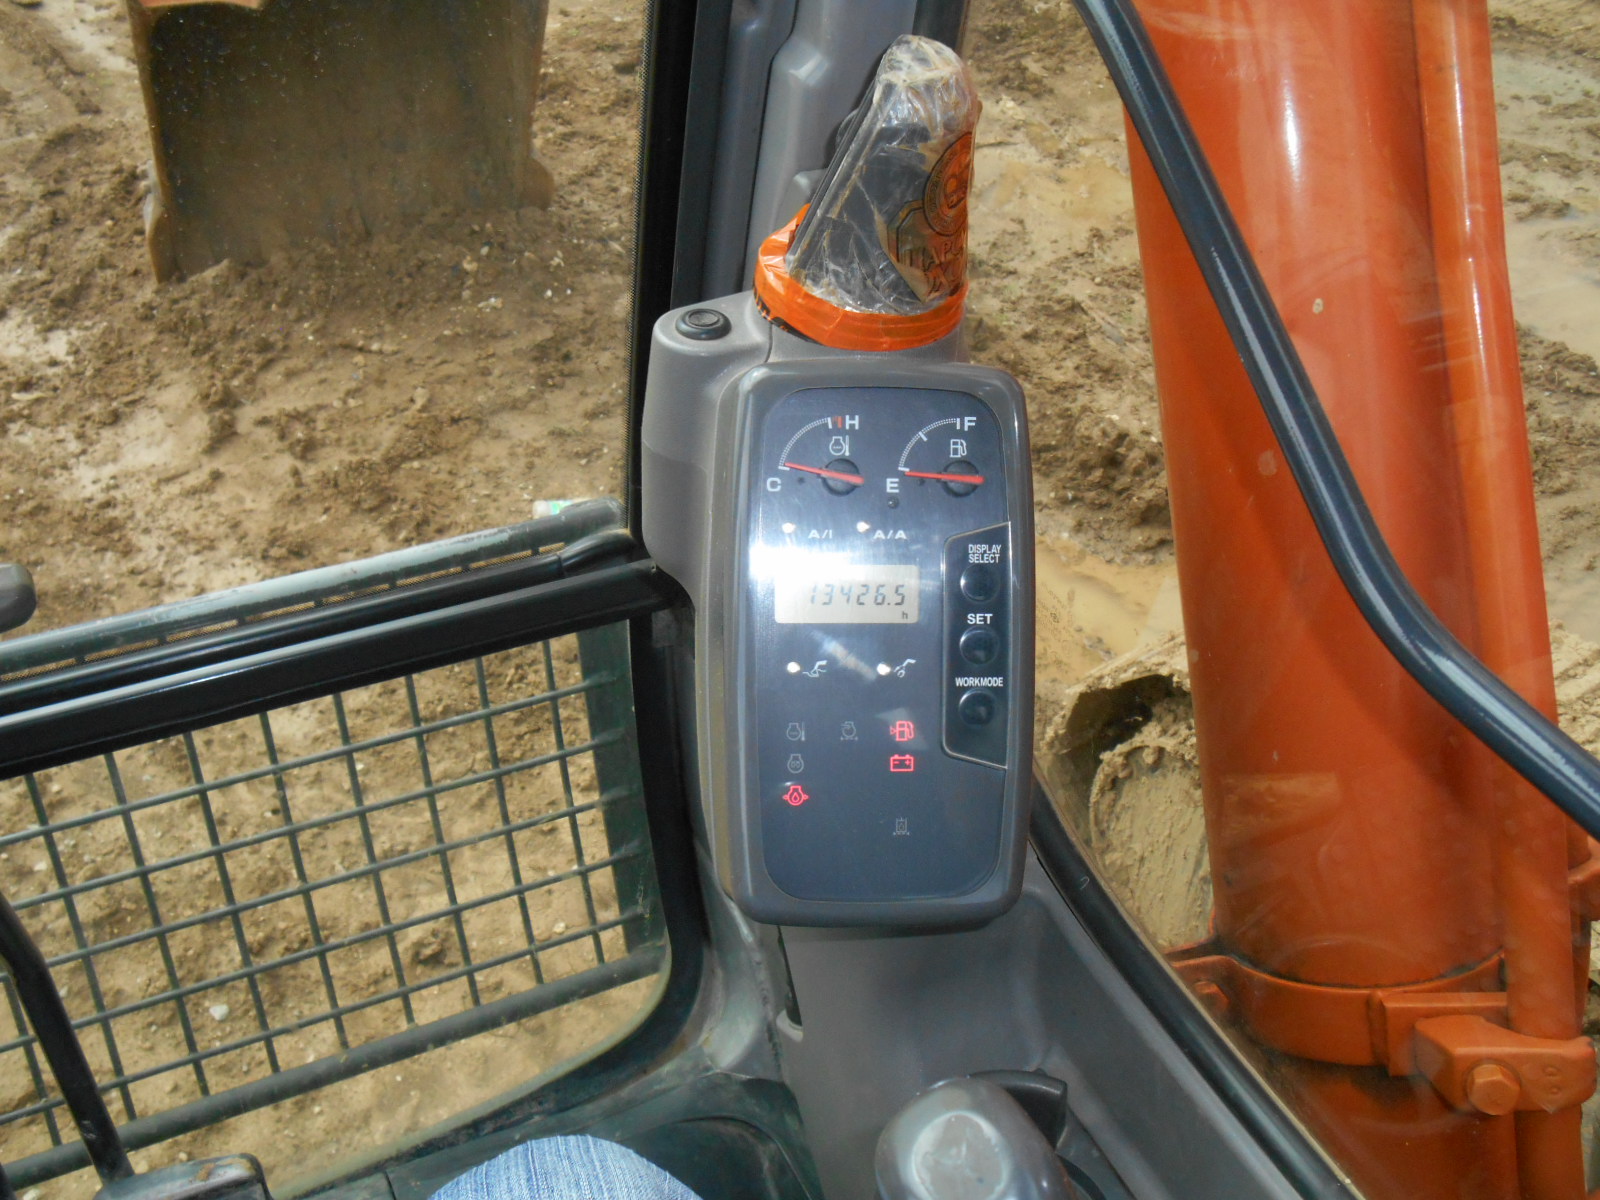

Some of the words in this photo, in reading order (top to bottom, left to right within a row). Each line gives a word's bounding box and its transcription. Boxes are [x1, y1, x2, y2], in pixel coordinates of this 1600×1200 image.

[845, 415, 859, 430] H
[964, 416, 977, 431] F
[766, 477, 782, 493] C
[886, 478, 900, 493] E
[808, 529, 833, 539] A/I
[873, 529, 907, 540] A/A
[968, 544, 1001, 554] DISPLAY
[968, 554, 1000, 564] SELECT
[967, 613, 993, 625] SET
[955, 676, 1004, 687] WORKMODE
